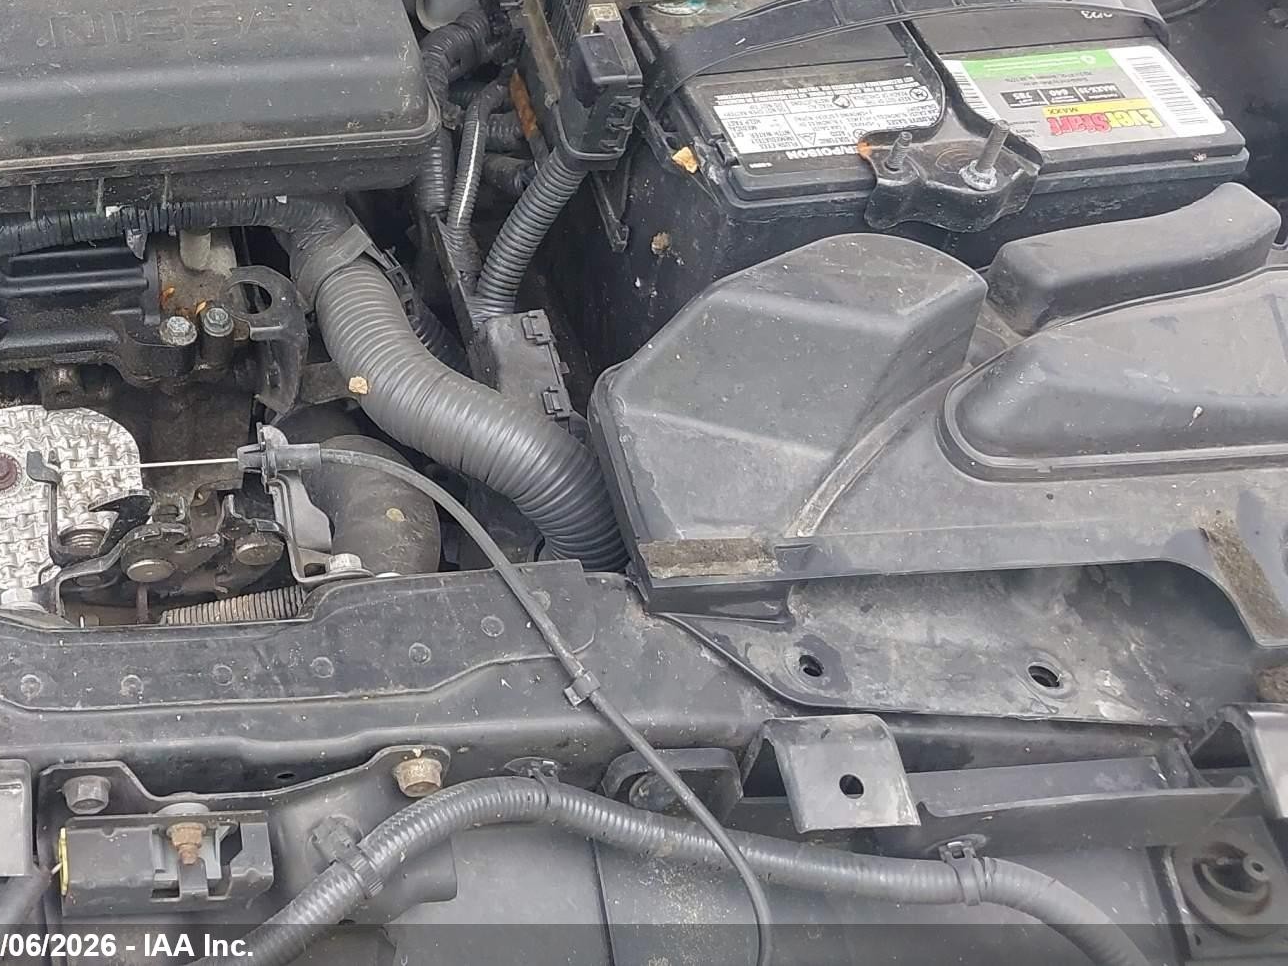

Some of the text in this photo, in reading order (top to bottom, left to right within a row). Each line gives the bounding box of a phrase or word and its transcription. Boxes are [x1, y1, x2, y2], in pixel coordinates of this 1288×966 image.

[1047, 107, 1079, 115] MAXX
[1046, 108, 1164, 136] EverStart
[785, 145, 859, 160] ER/POISON
